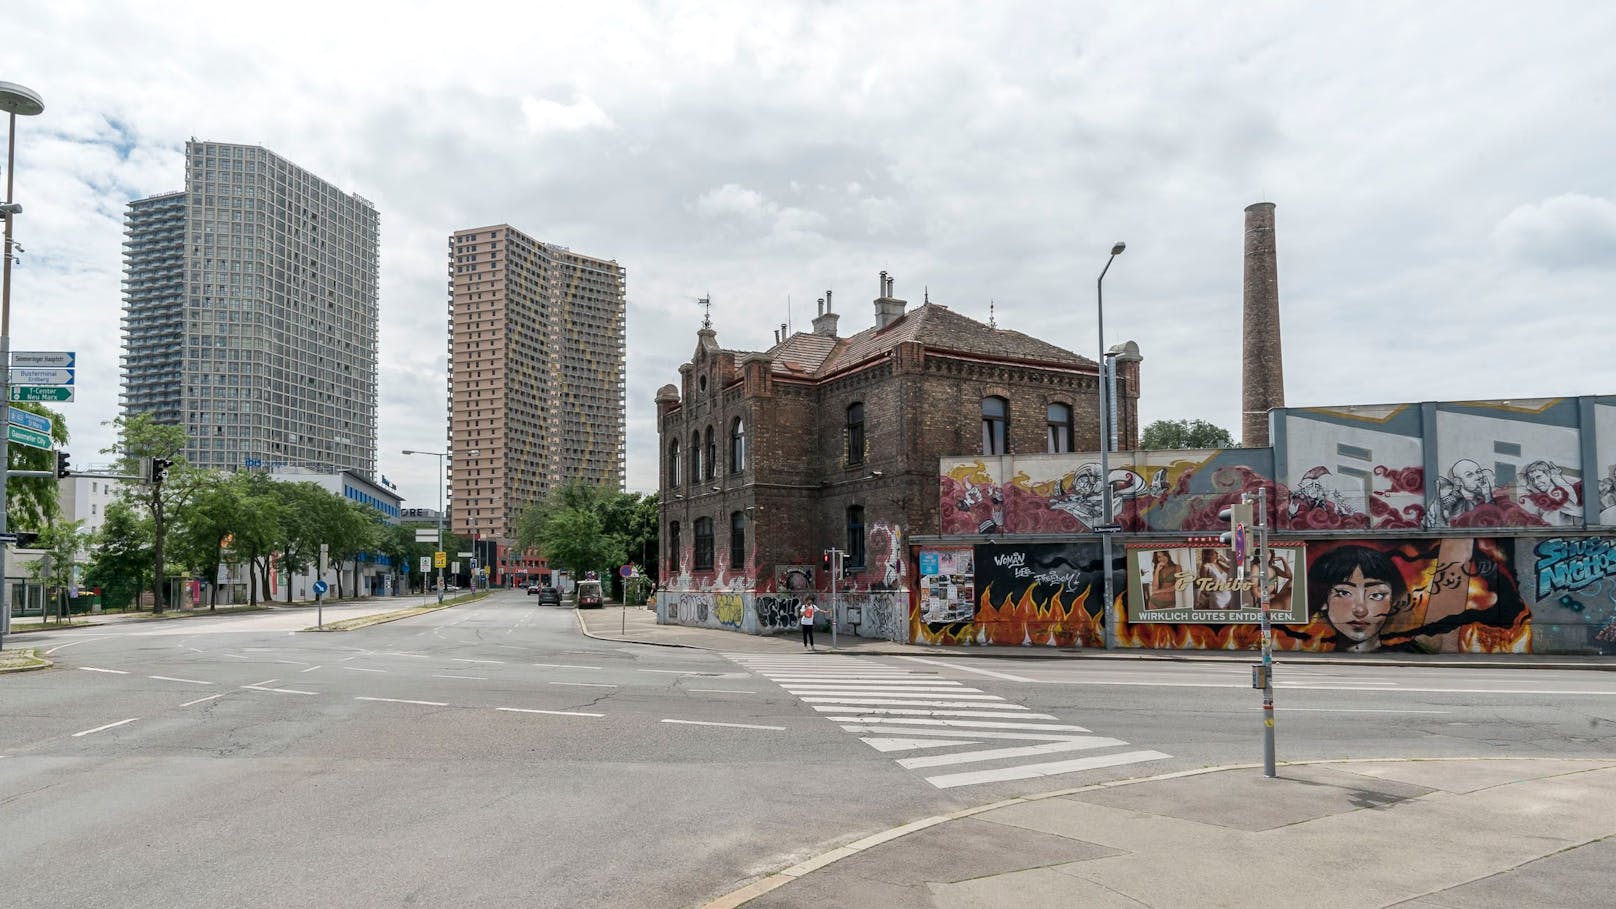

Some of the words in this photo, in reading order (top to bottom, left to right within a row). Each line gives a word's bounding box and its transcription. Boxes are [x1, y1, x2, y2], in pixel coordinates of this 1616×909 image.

[993, 552, 1026, 569] WOMAN
[1196, 576, 1256, 592] Tchibo
[1138, 612, 1189, 621] WIRKLICH
[1191, 612, 1226, 621] GUTES
[1229, 612, 1296, 621] ENTDEKEN.
